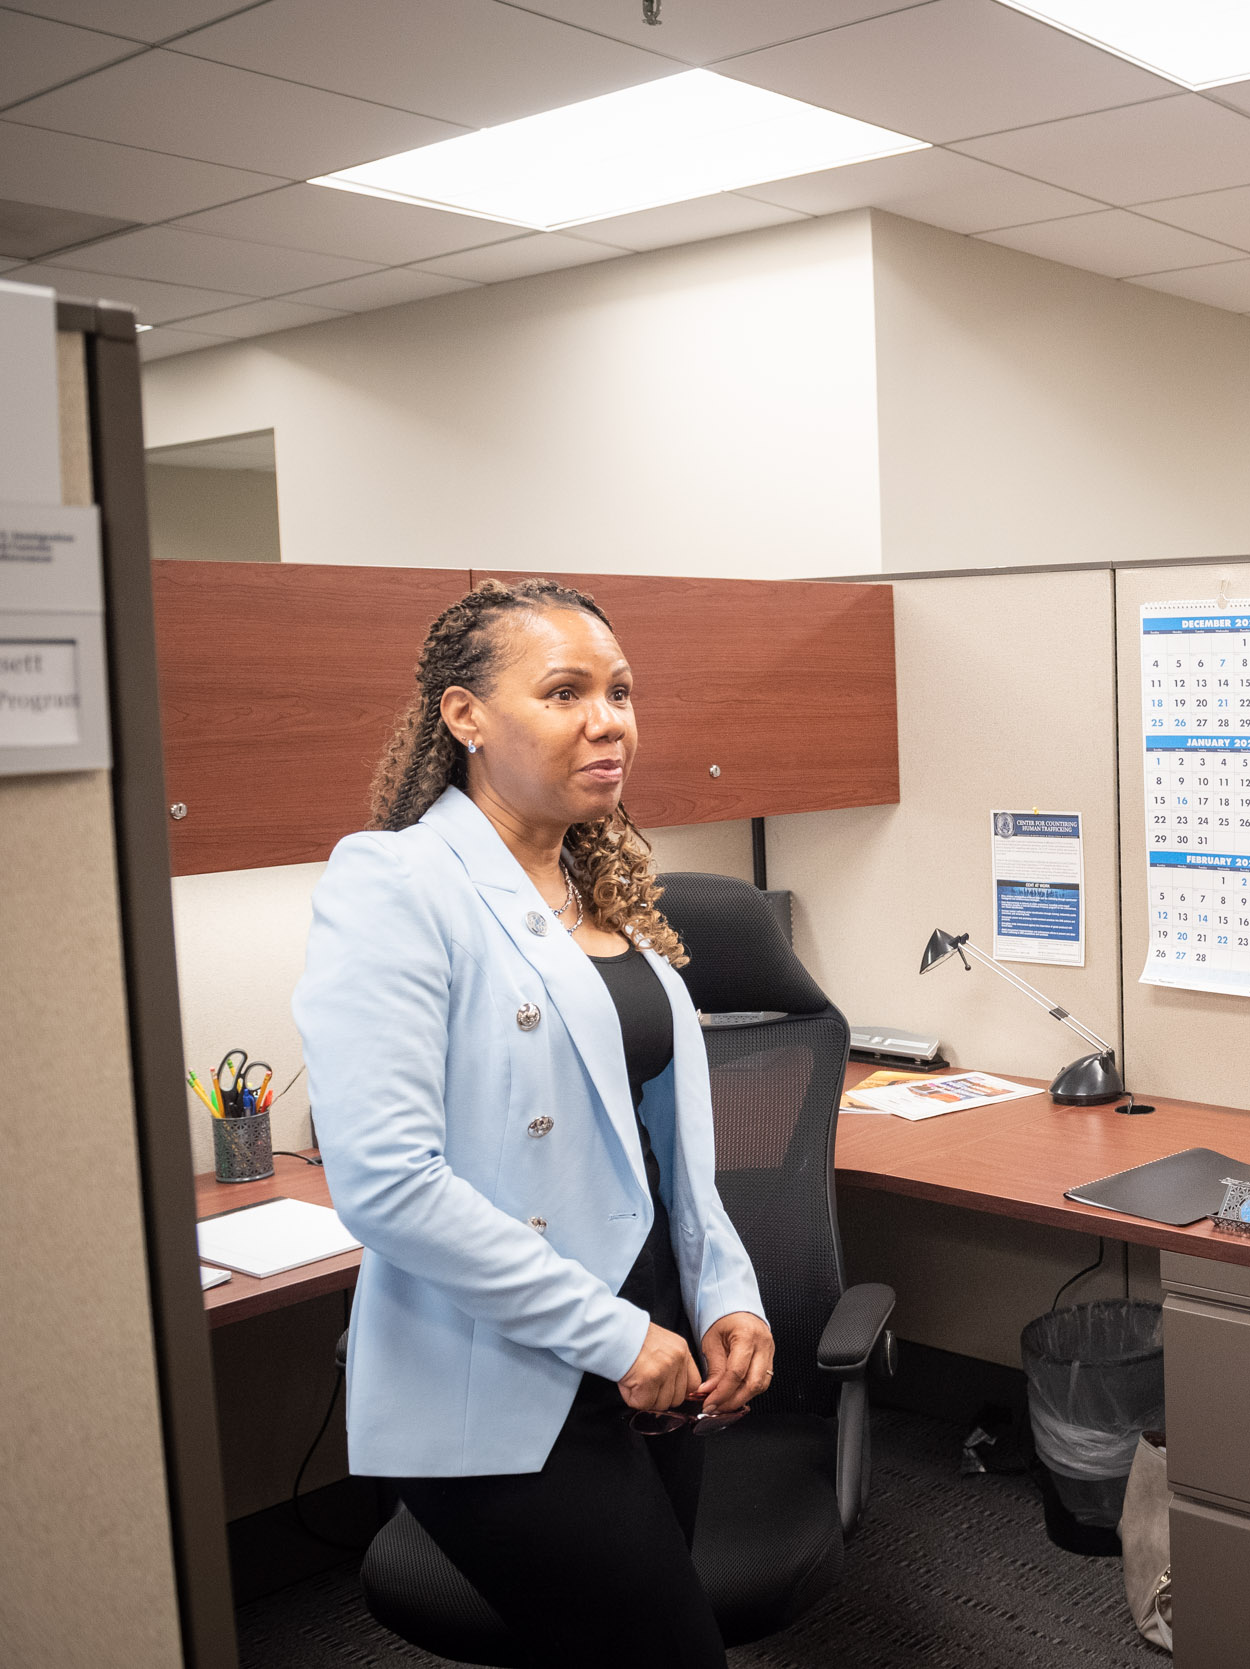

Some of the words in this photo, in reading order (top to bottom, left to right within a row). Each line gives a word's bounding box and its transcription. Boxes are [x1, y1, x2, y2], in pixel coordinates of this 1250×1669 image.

[1182, 619, 1231, 628] DECEMBER
[1176, 659, 1182, 668] 5
[1197, 659, 1204, 668] 6
[1220, 659, 1226, 667] 7
[1242, 658, 1248, 667] 8
[1151, 679, 1161, 688] 11
[1174, 679, 1185, 688] 12
[1196, 679, 1207, 688] 13
[1218, 679, 1229, 687] 14
[1240, 679, 1250, 687] 15
[1152, 699, 1163, 708] 18
[1175, 699, 1186, 707] 19
[1196, 699, 1208, 708] 20
[1217, 698, 1228, 707] 21
[1239, 698, 1250, 707] 22
[1151, 719, 1164, 727] 25
[1174, 718, 1187, 727] 26
[1196, 718, 1208, 727] 27
[1218, 718, 1229, 727] 28
[1186, 738, 1230, 747] JANUARY
[1178, 757, 1184, 766] 2
[1200, 757, 1206, 766] 3
[1221, 758, 1227, 766] 4
[1242, 758, 1248, 767] 5
[1156, 776, 1162, 785] 8
[1178, 777, 1185, 785] 9
[1198, 777, 1209, 786] 10
[1219, 778, 1229, 786] 11
[1240, 778, 1250, 787] 12
[1154, 796, 1166, 805] 15
[1177, 797, 1188, 805] 16
[1198, 797, 1209, 806] 17
[1219, 798, 1230, 807] 18
[1240, 798, 1250, 807] 19
[1154, 815, 1166, 824] 22
[1176, 816, 1188, 825] 23
[1197, 816, 1209, 825] 24
[1218, 817, 1230, 826] 25
[1239, 818, 1250, 827] 26
[1154, 834, 1167, 843] 29
[1177, 835, 1189, 844] 30
[1197, 836, 1208, 845] 31
[1186, 856, 1232, 866] FEBRUARY
[1241, 878, 1247, 886] 2
[1159, 892, 1165, 900] 5
[1180, 893, 1186, 902] 6
[1200, 895, 1206, 903] 7
[1220, 896, 1226, 905] 8
[1241, 897, 1247, 906] 9
[1158, 911, 1168, 920] 12
[1178, 912, 1188, 921] 13
[1198, 914, 1208, 922] 14
[1218, 916, 1228, 925] 15
[1239, 917, 1250, 927] 16
[1158, 930, 1168, 939] 19
[1177, 932, 1188, 941] 20
[1197, 933, 1207, 942] 21
[1217, 935, 1228, 945] 22
[1238, 937, 1249, 946] 23
[1156, 949, 1166, 958] 26
[1176, 951, 1186, 960] 27
[1196, 953, 1207, 962] 28
